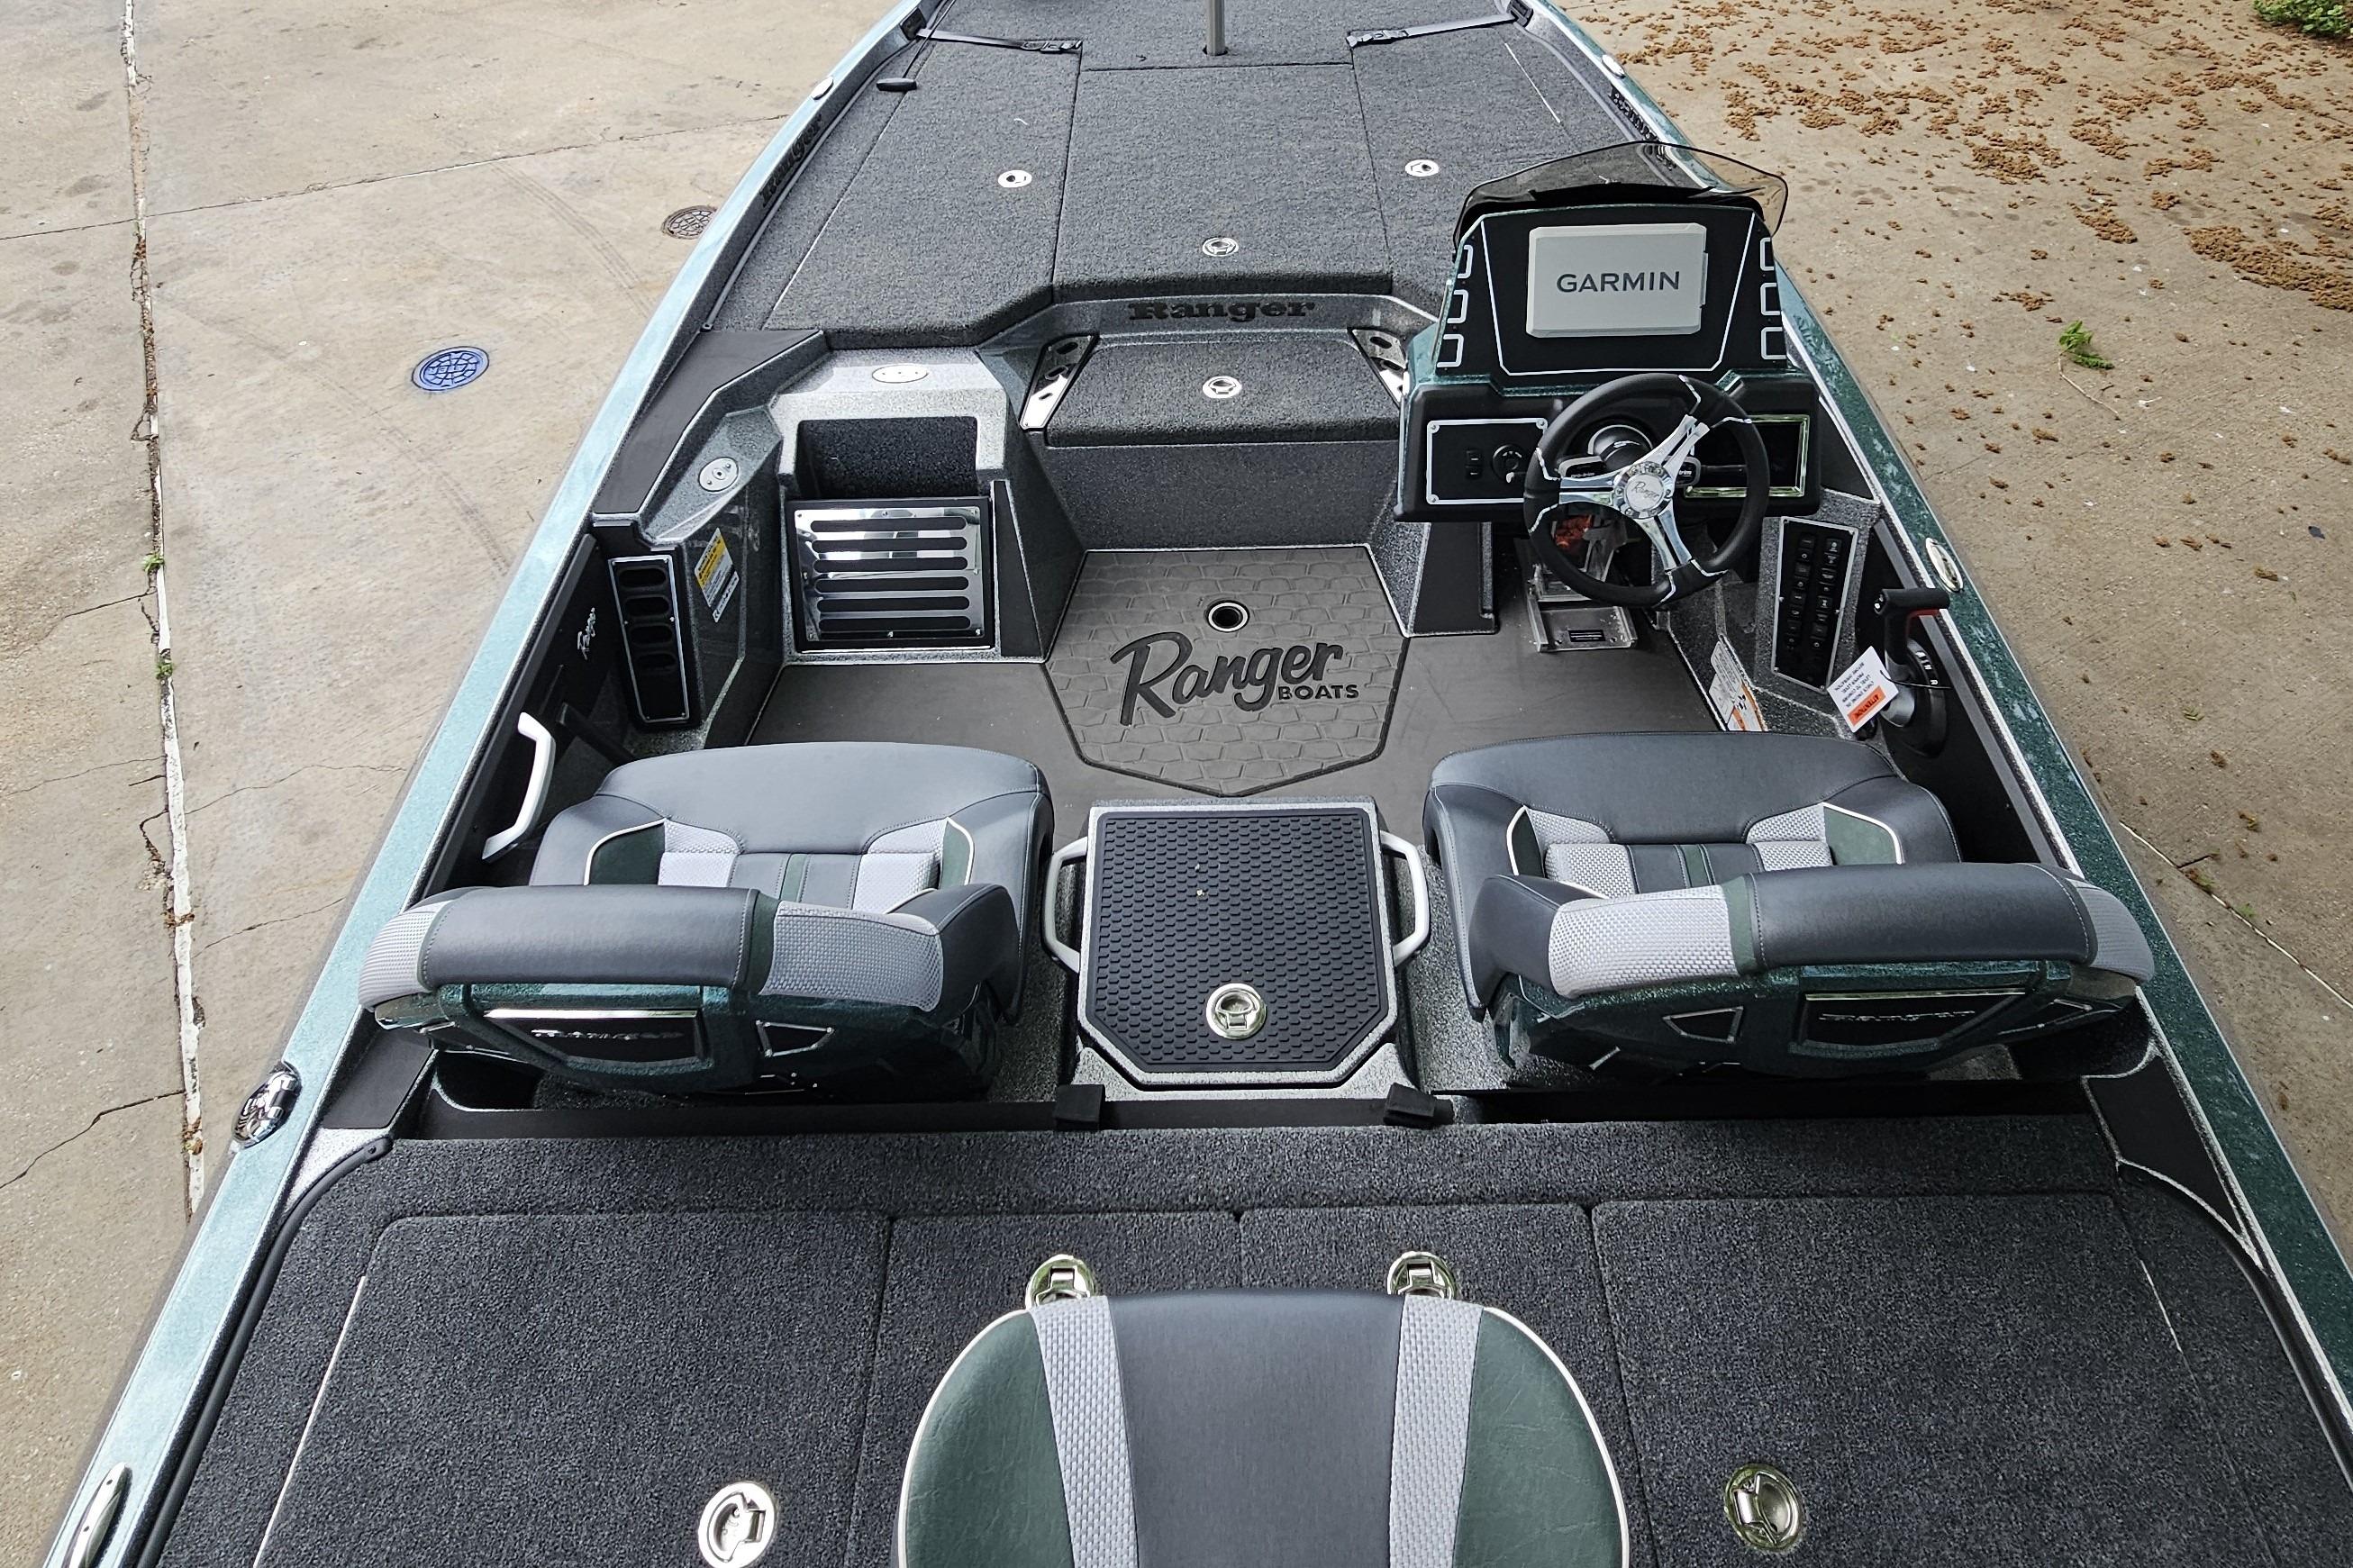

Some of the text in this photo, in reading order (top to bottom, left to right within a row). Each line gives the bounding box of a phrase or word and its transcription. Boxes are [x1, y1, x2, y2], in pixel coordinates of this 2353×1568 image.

[1557, 271, 1680, 293] GARMIN
[1128, 301, 1315, 322] Ranger
[1632, 481, 1659, 501] Ranger
[1110, 631, 1359, 726] Ranger BOATS
